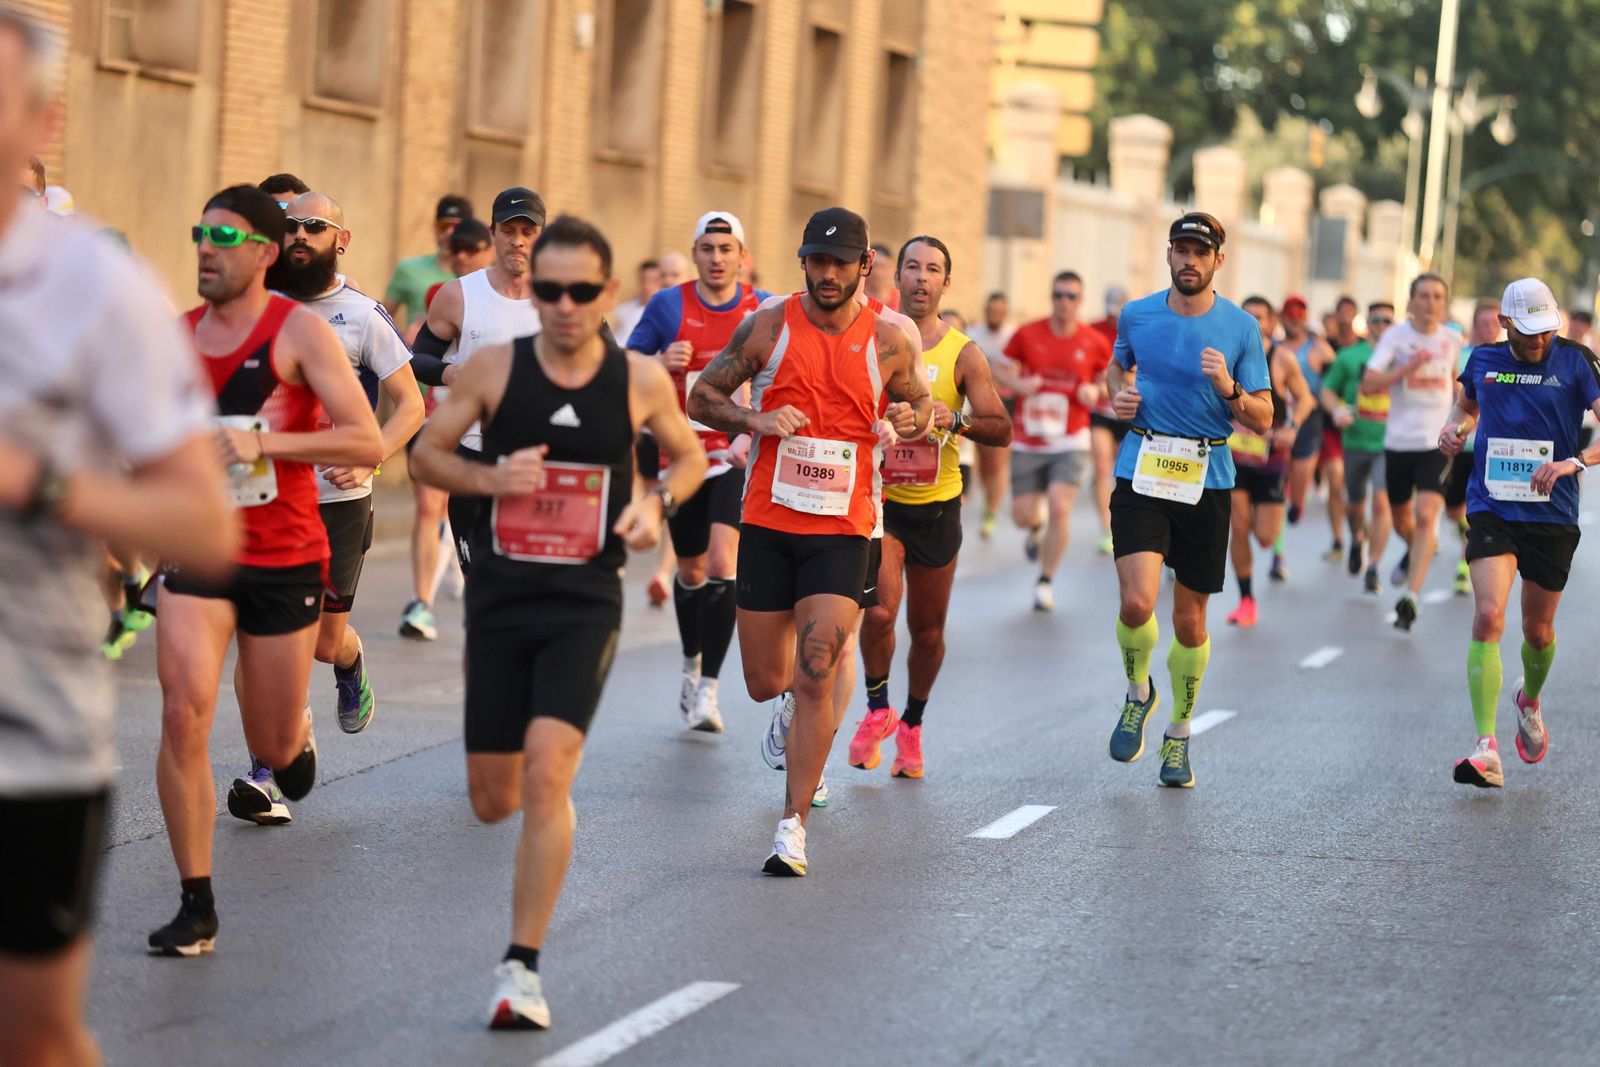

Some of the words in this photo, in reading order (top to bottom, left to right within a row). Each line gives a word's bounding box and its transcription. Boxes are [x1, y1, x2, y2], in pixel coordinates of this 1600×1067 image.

[1515, 373, 1543, 385] TEAM
[894, 449, 914, 459] 717
[1155, 457, 1189, 473] 10955
[1500, 461, 1534, 473] 11812
[796, 463, 835, 480] 10389
